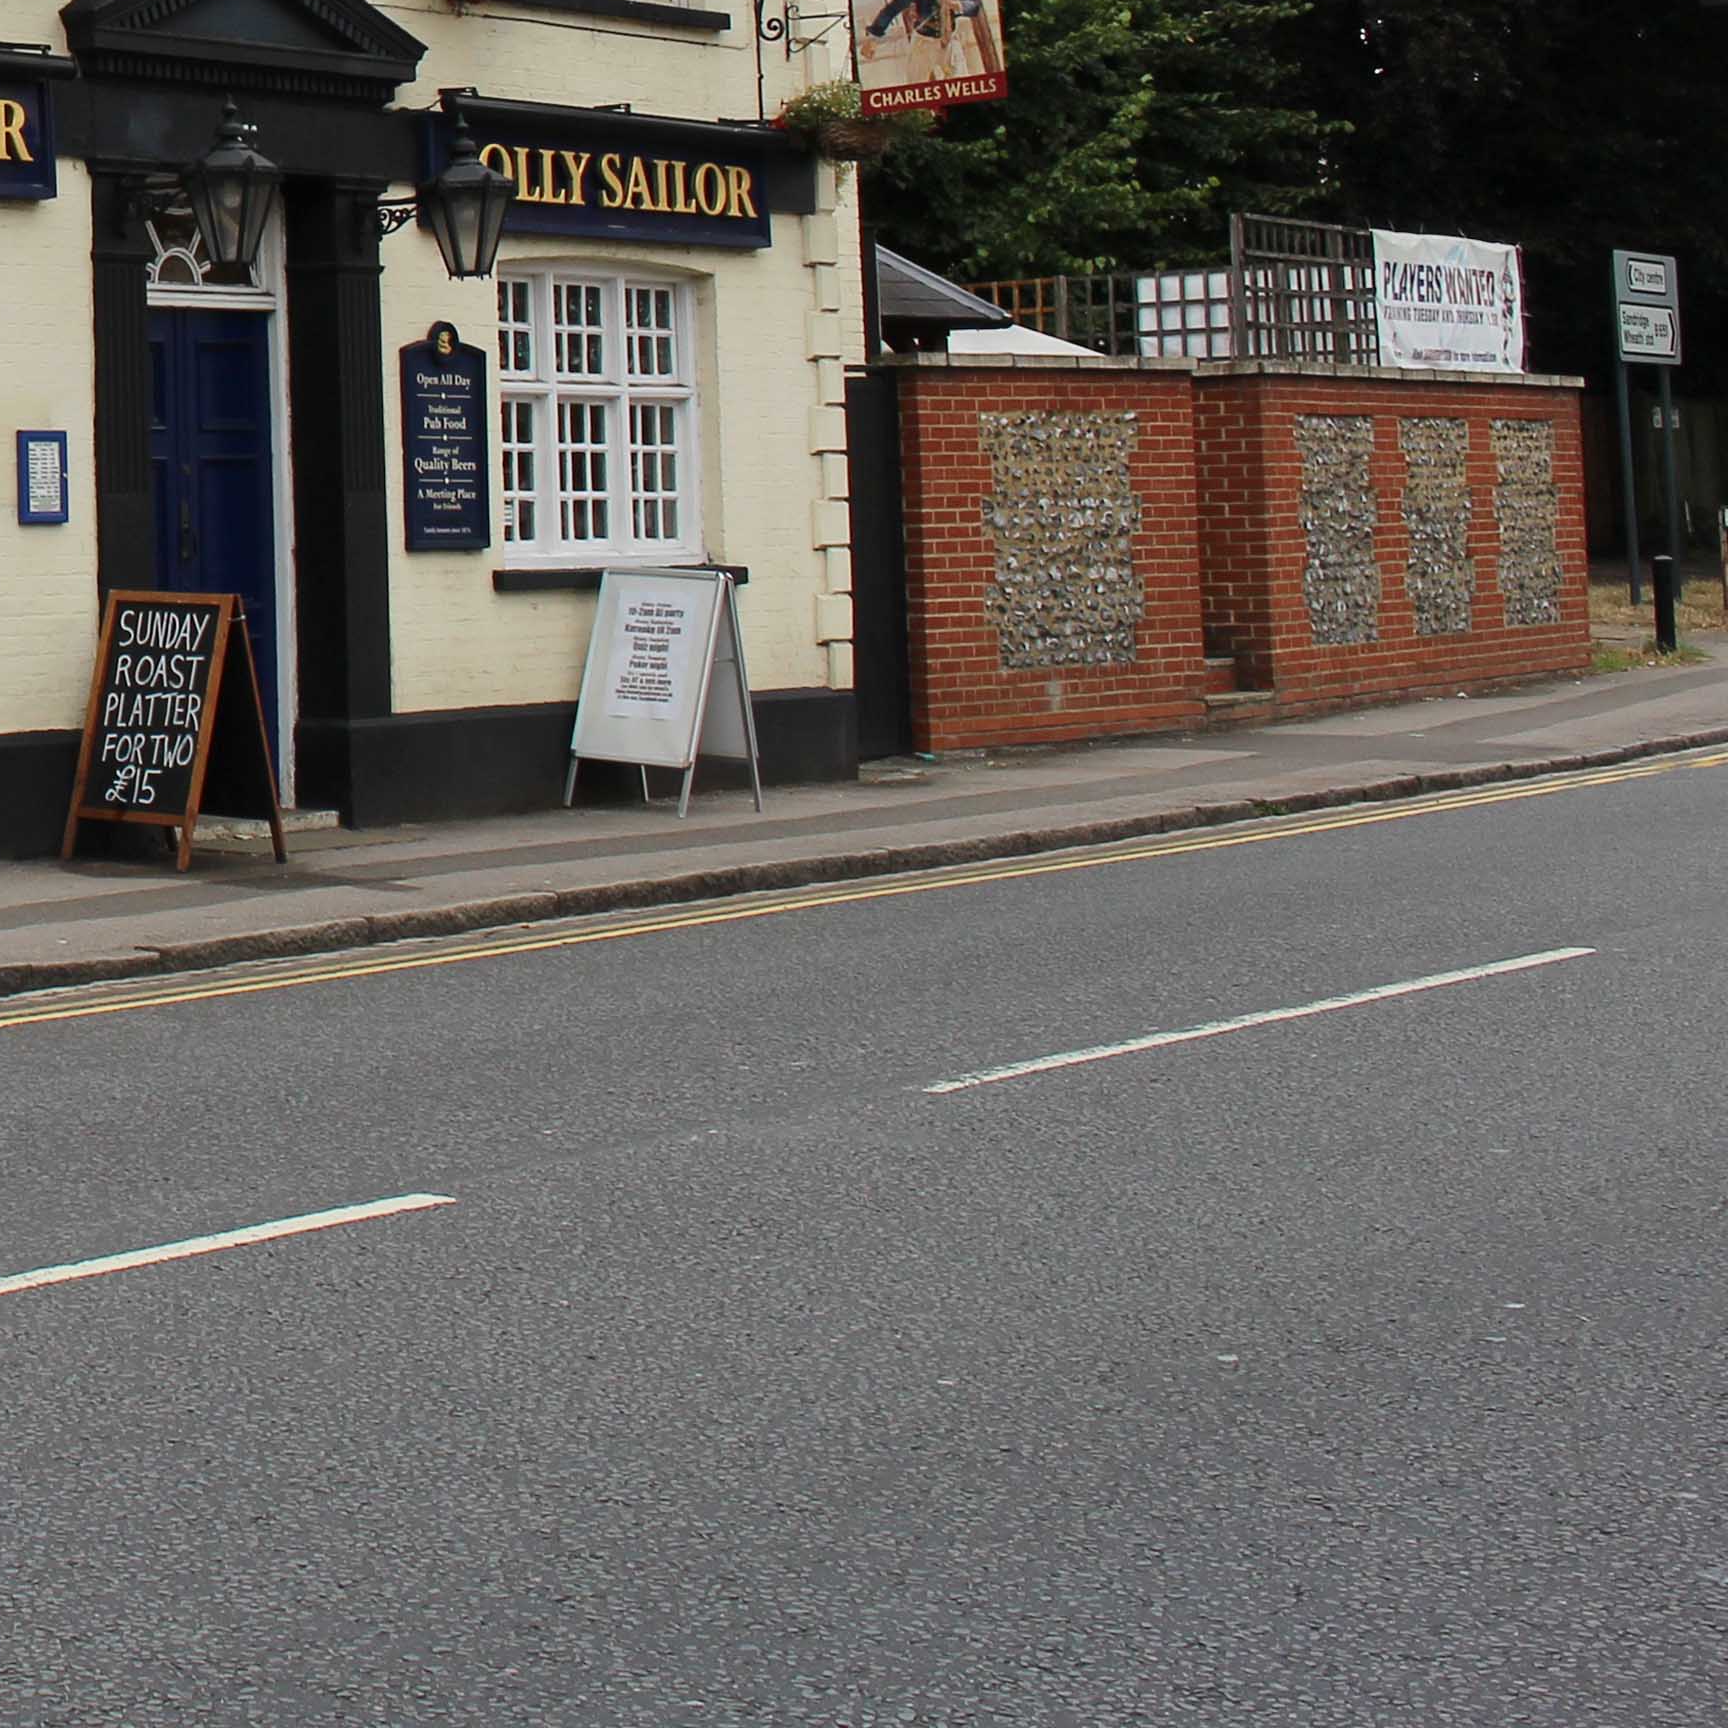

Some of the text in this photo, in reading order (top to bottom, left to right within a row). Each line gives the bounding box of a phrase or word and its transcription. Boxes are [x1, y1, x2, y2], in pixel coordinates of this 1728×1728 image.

[869, 78, 997, 108] CHARLES WELLS
[479, 143, 758, 218] OLLY SAILOR
[1383, 261, 1442, 303] PLAYERS
[416, 372, 472, 391] Open All Day
[424, 417, 467, 430] Pub Food
[415, 457, 476, 475] Quality Beers
[417, 488, 476, 502] A Meeting Place
[118, 609, 211, 651] SUNDAY
[114, 654, 205, 690] ROAST
[103, 692, 201, 732] PLATTER
[101, 733, 194, 768] FOR TWO
[104, 765, 162, 804] £15
